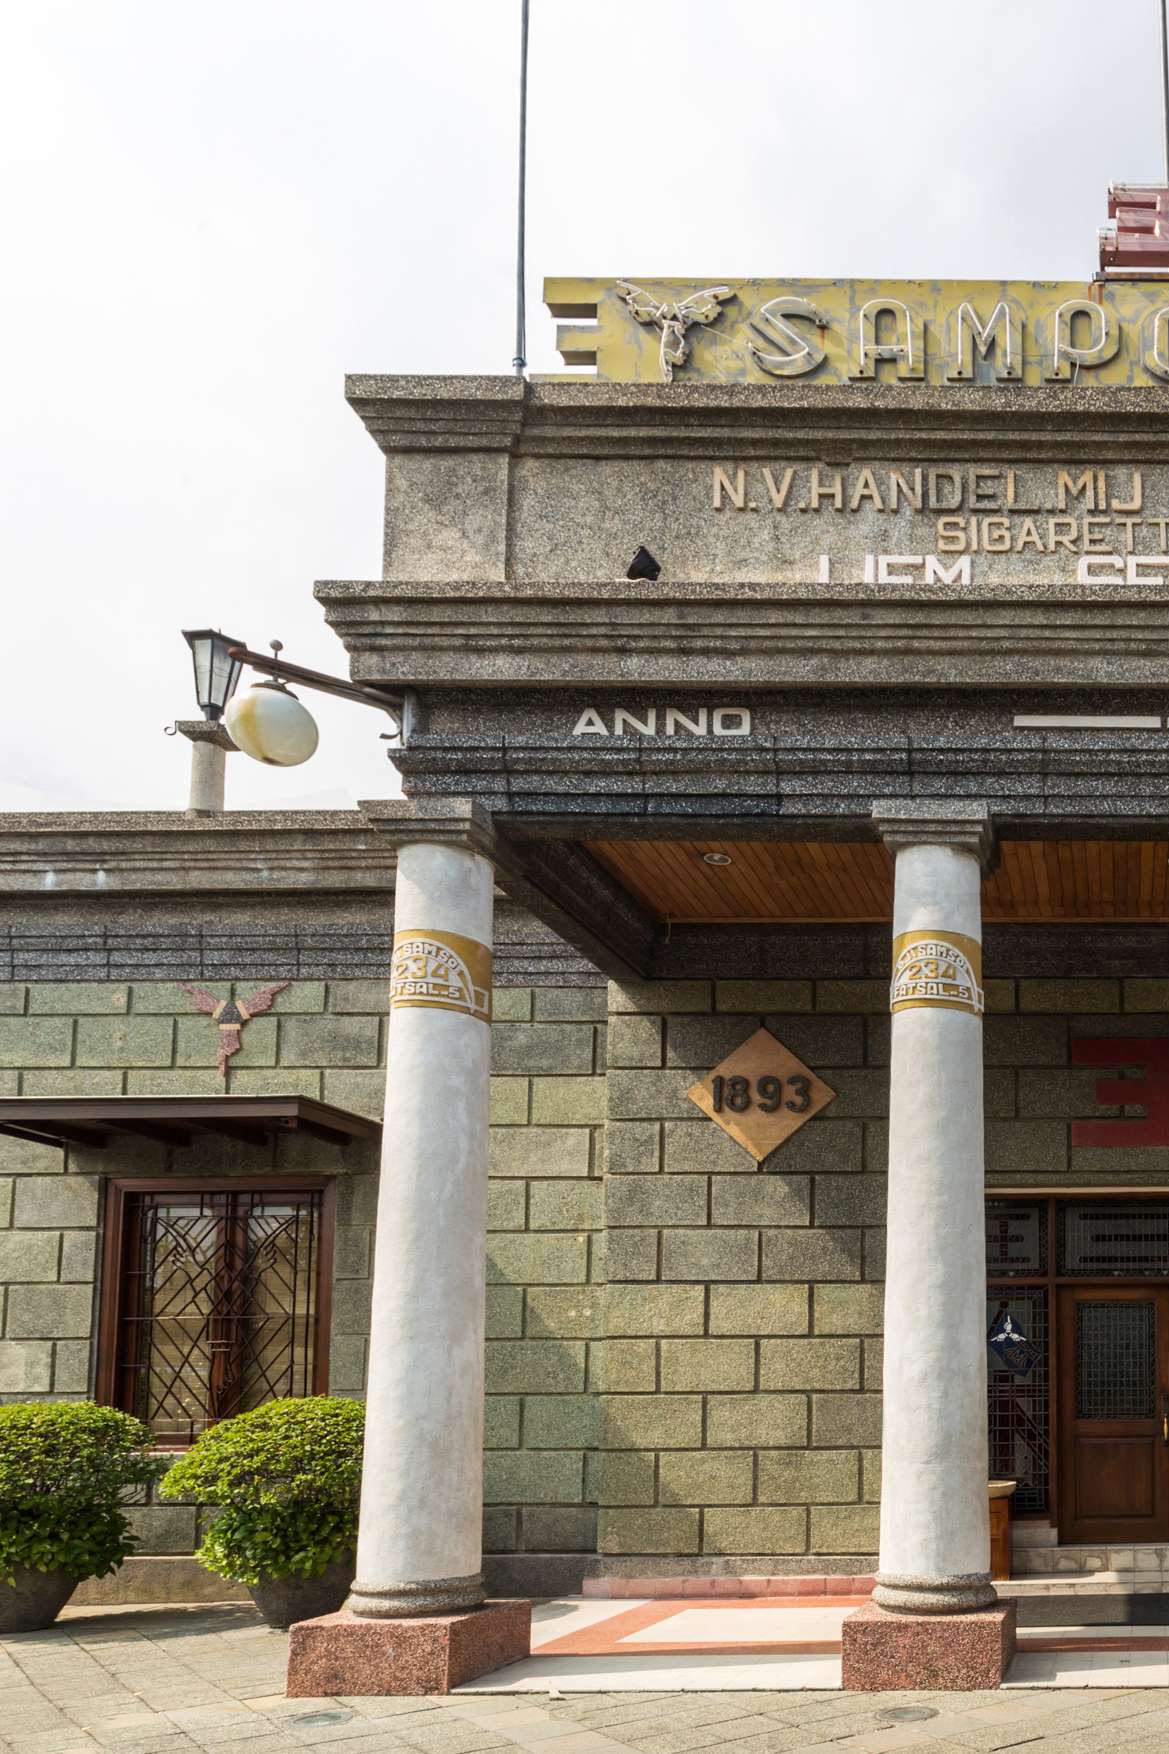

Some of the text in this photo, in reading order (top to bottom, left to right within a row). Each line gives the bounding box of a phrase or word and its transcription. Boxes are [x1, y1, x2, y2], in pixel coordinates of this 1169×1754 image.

[572, 707, 750, 735] ANNO
[919, 944, 947, 957] SAM
[394, 956, 449, 982] 234
[908, 959, 957, 981] 234
[712, 1075, 811, 1114] 1893
